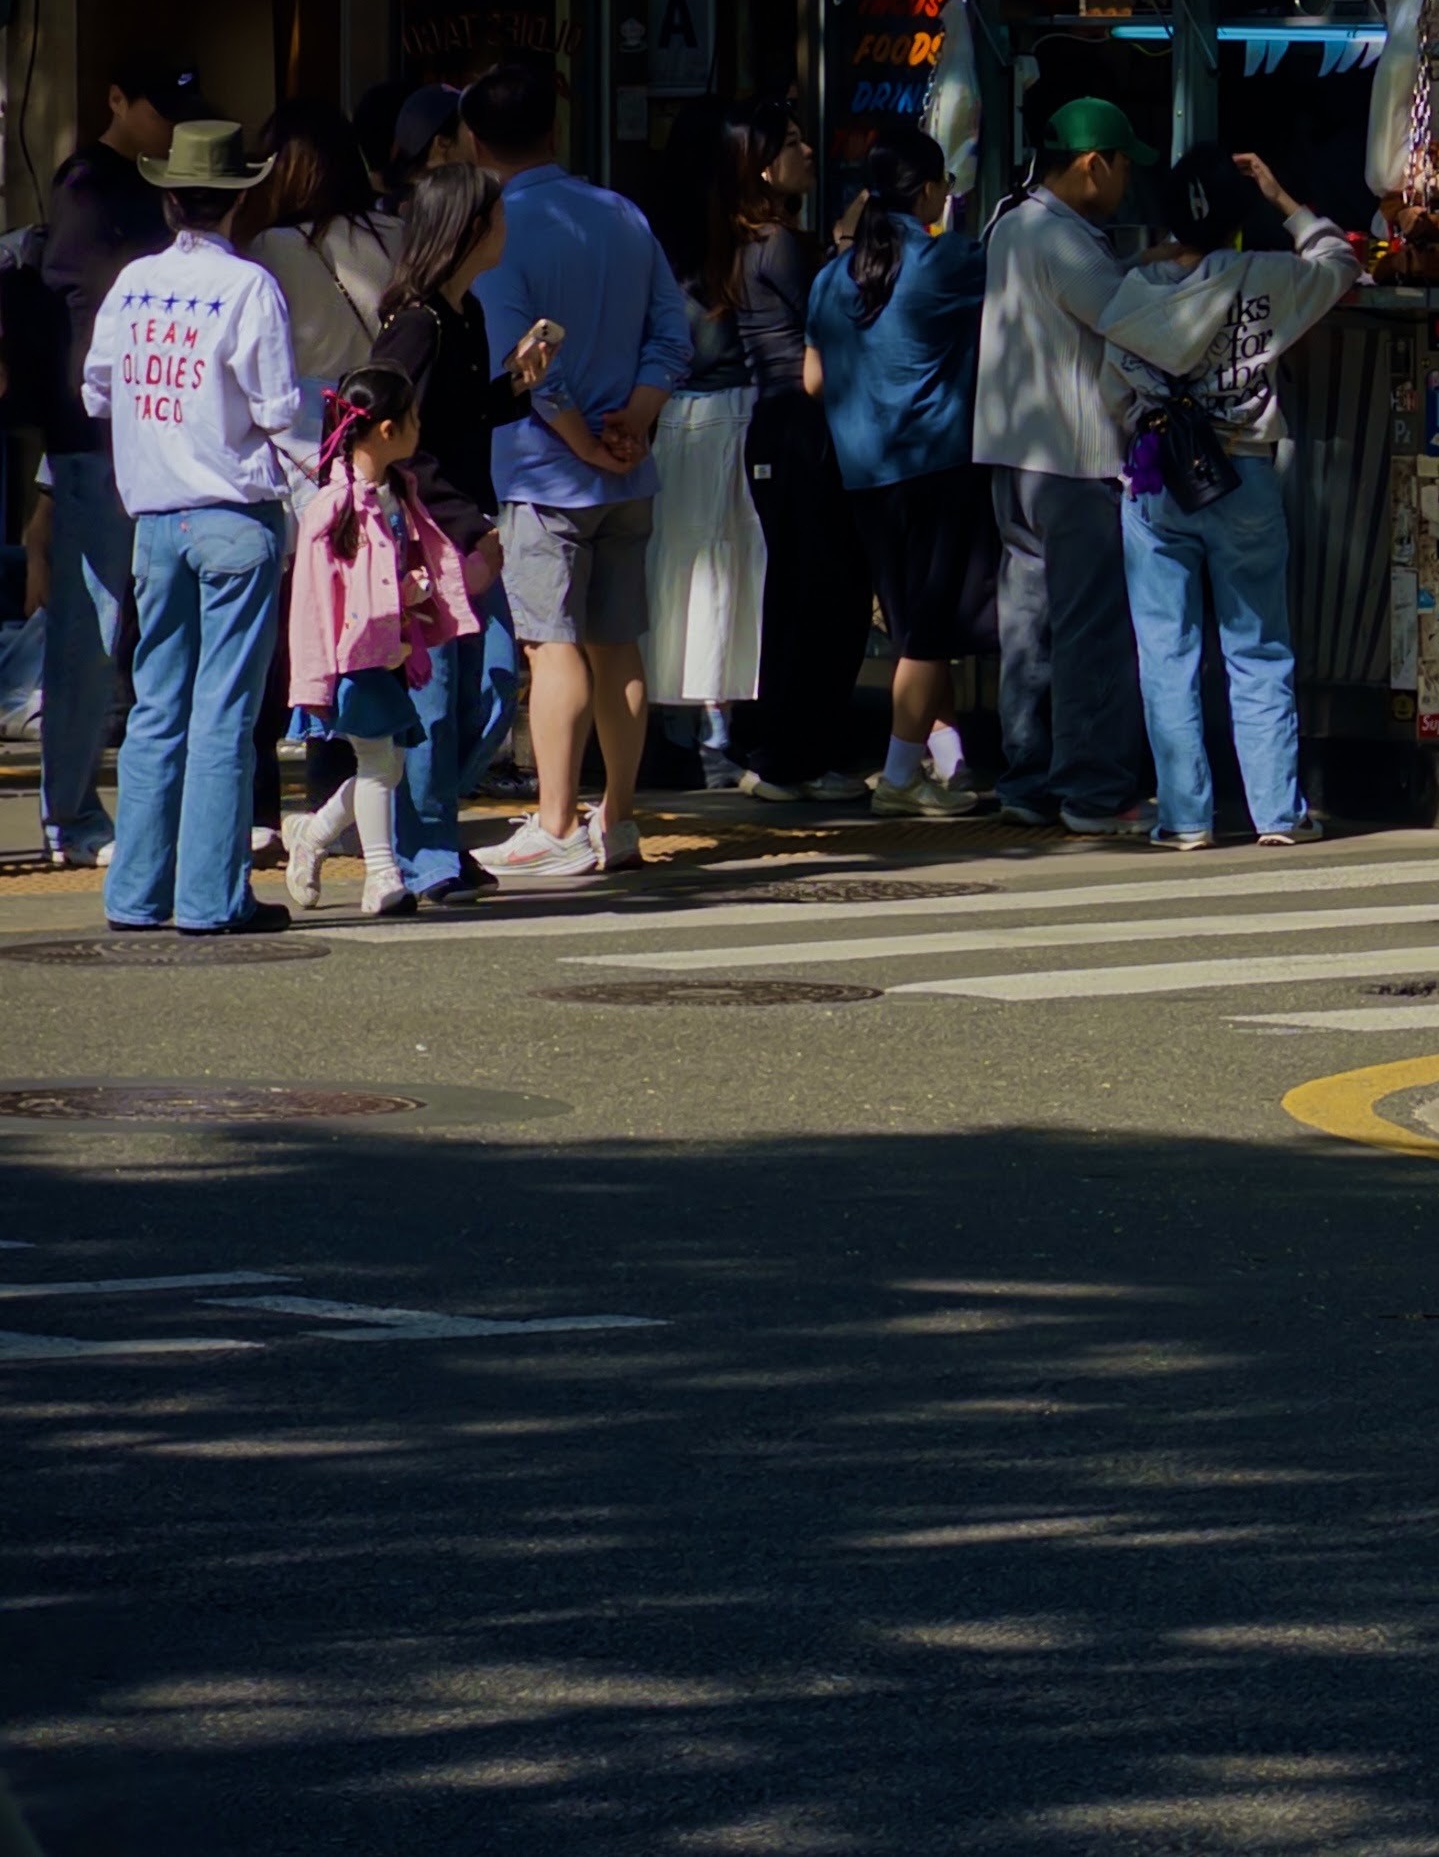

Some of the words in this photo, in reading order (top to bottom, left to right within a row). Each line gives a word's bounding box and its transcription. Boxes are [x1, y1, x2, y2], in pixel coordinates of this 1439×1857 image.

[850, 79, 924, 116] DRIN
[131, 318, 198, 349] TEAM
[1228, 324, 1273, 372] for
[123, 353, 206, 390] OLDIES
[134, 394, 184, 424] TACO
